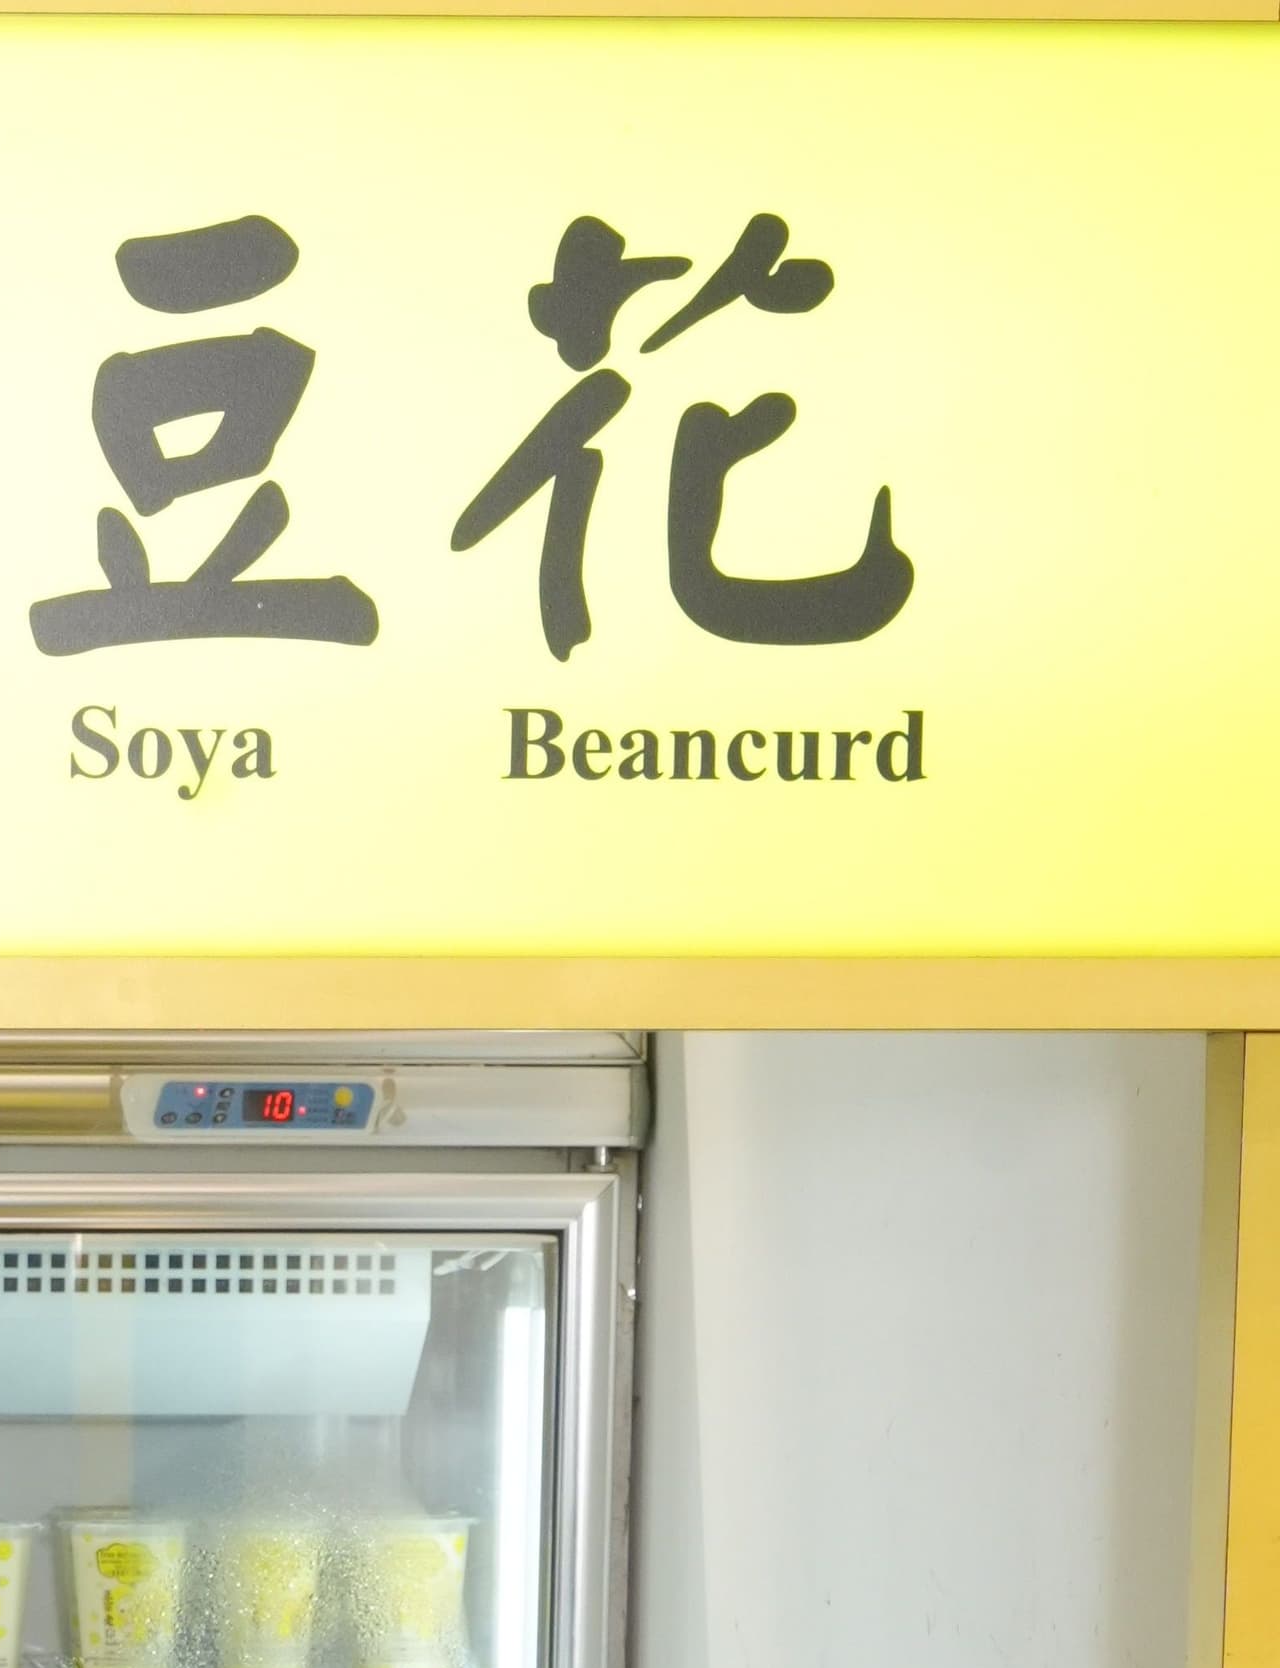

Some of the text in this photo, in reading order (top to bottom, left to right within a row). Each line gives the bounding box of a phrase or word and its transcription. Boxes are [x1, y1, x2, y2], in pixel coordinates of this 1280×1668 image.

[67, 703, 278, 801] Soya
[500, 703, 928, 786] Beancurd
[262, 1091, 292, 1122] 10
